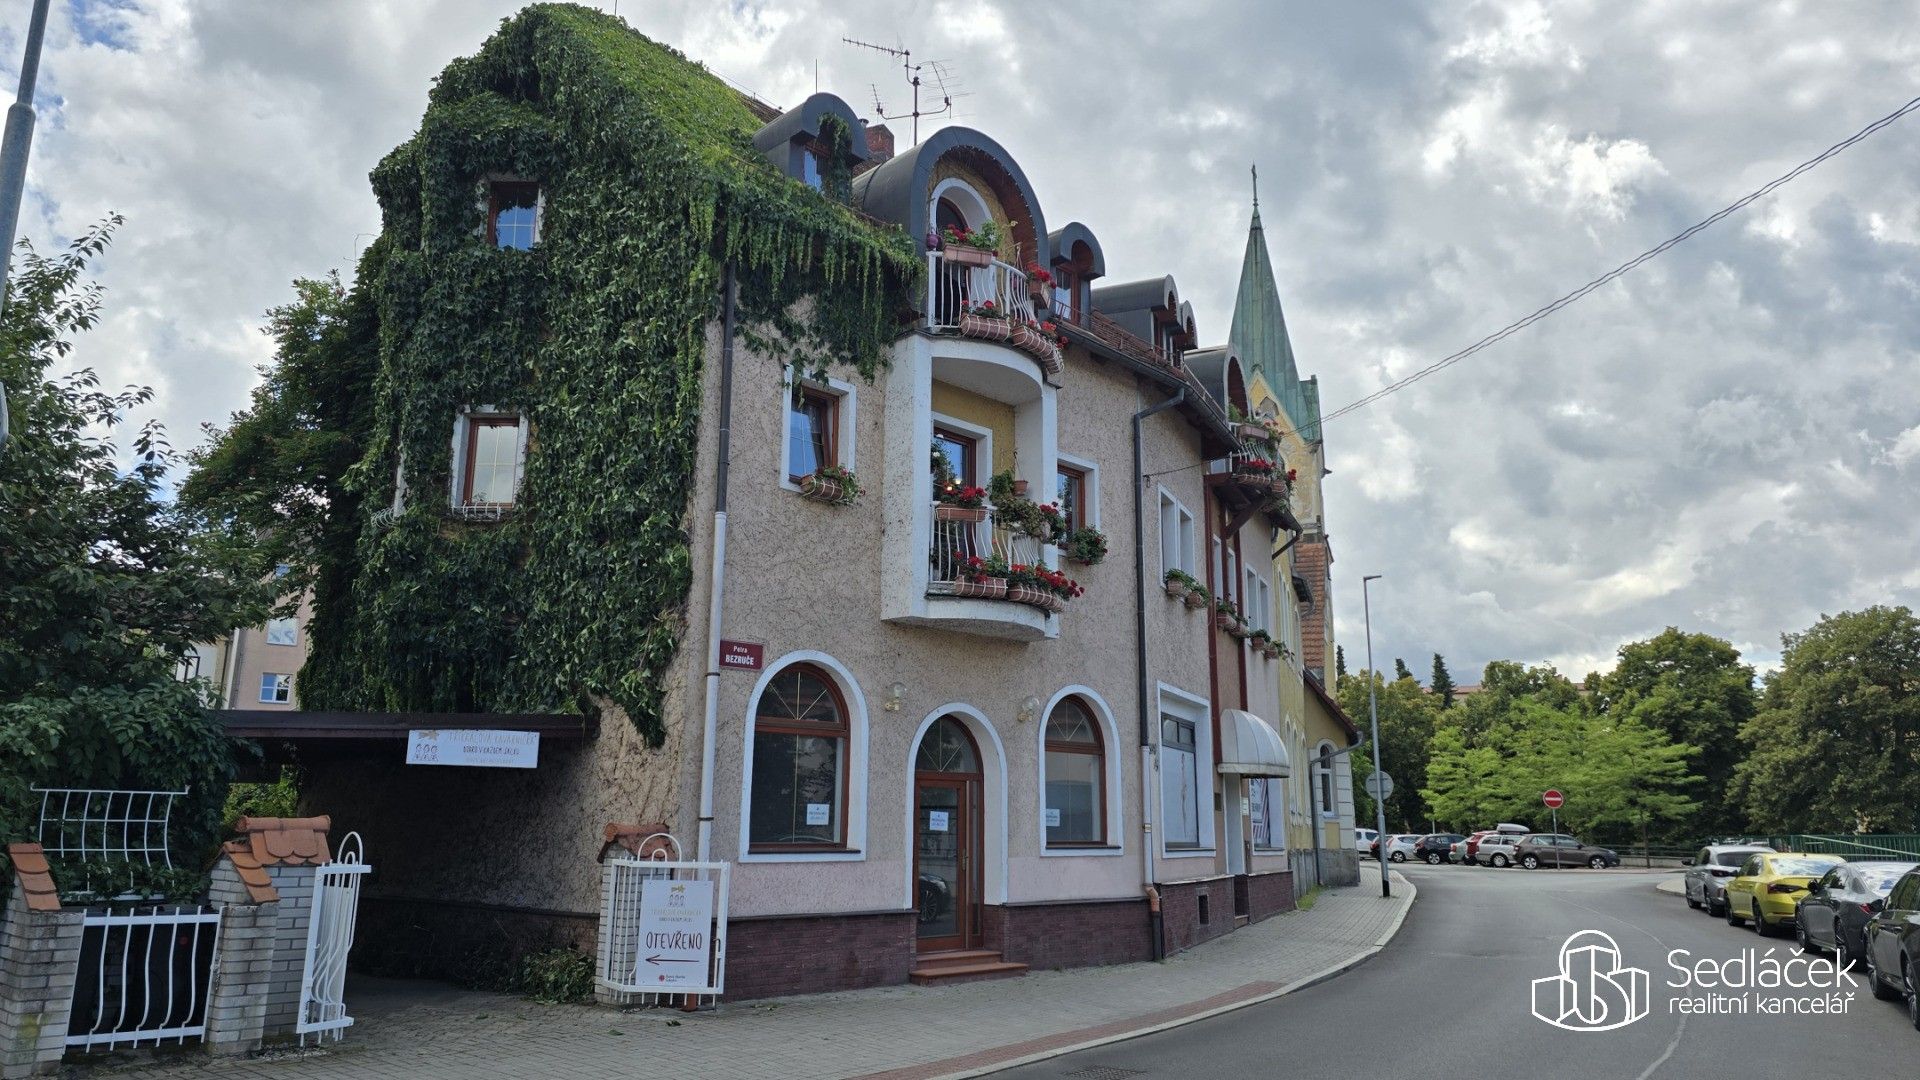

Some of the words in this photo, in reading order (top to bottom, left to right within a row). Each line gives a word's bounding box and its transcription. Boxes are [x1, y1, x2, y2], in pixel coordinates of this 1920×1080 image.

[733, 645, 748, 654] Petra
[725, 654, 754, 666] BEZRUČE
[646, 930, 703, 950] OTEVŘENO
